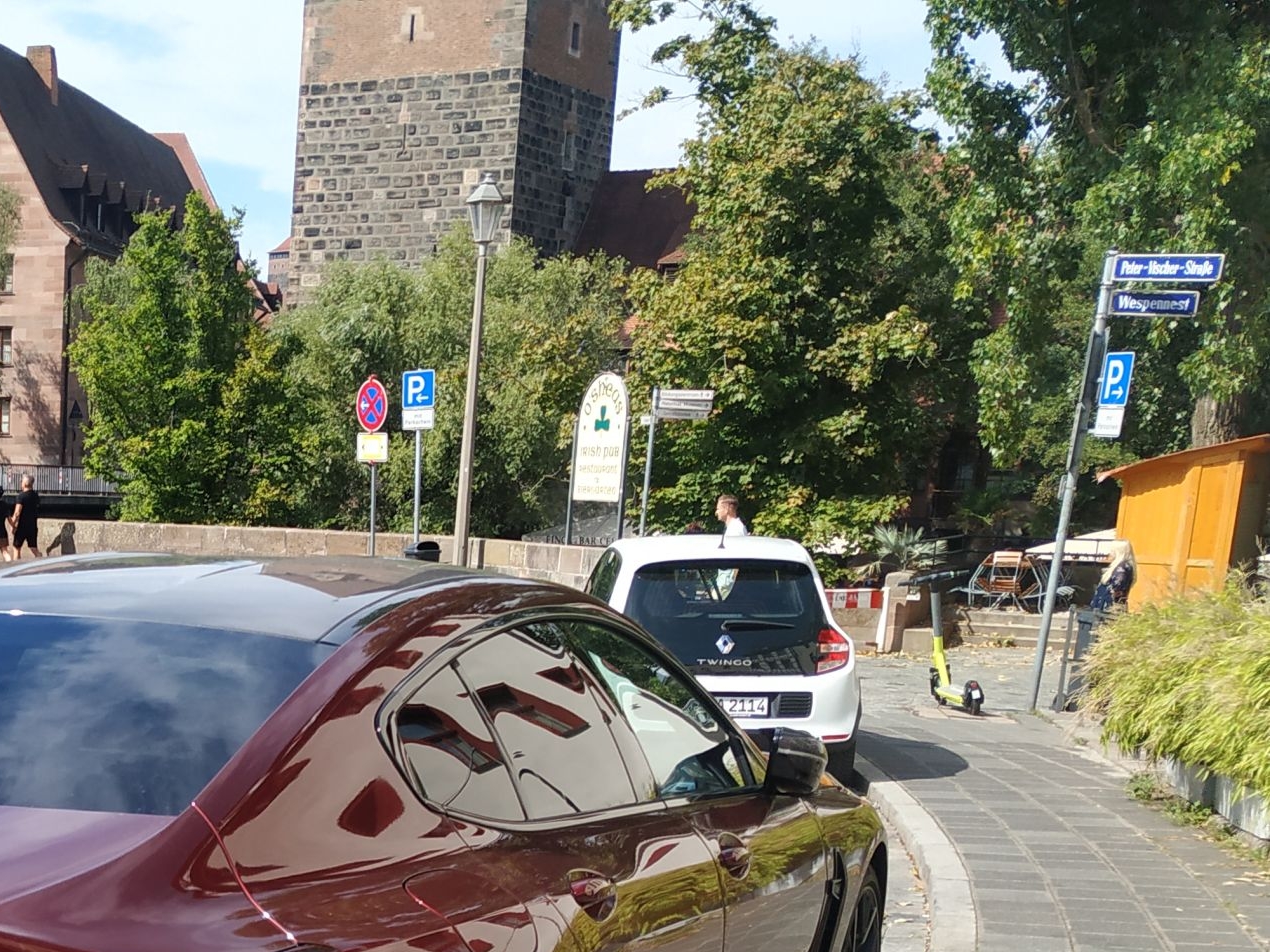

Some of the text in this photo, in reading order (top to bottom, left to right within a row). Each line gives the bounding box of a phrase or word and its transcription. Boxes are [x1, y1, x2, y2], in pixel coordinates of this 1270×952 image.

[1120, 259, 1214, 276] Peter-Vischer-Straße
[1118, 294, 1191, 312] Wespennest
[1103, 359, 1125, 400] P
[407, 375, 425, 404] P
[546, 535, 572, 545] FINC
[579, 536, 596, 545] BAR
[696, 658, 753, 667] TWINGO
[729, 698, 765, 713] 2114
